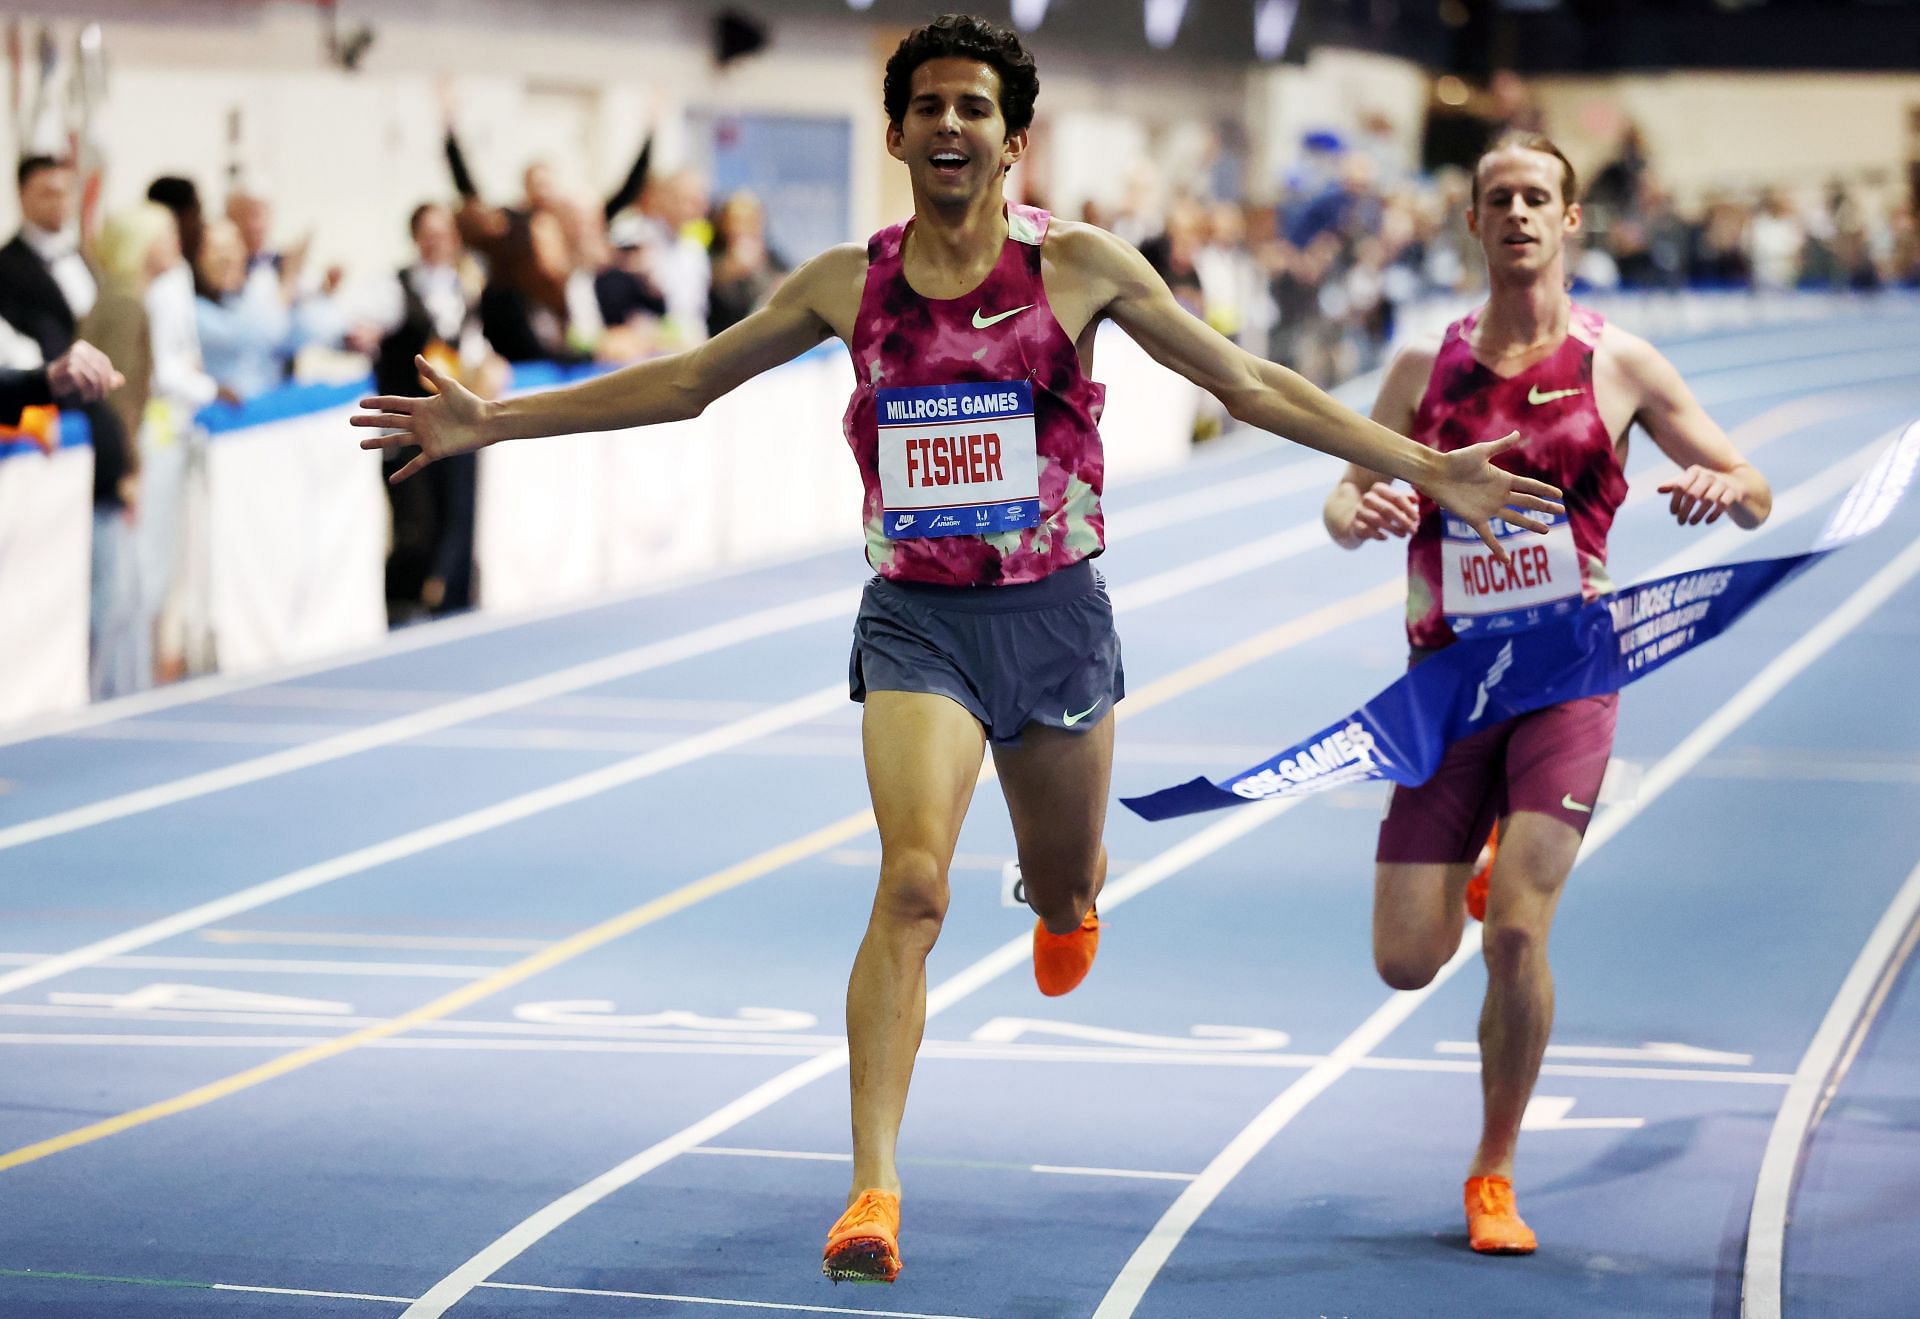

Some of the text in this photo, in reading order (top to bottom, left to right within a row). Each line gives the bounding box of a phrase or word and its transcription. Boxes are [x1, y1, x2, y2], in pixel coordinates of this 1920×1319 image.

[886, 392, 1018, 420] MILLROSE GAMES
[905, 432, 1003, 488] FISHER
[1460, 545, 1552, 596] HOCKER
[1279, 722, 1375, 783] GAMES
